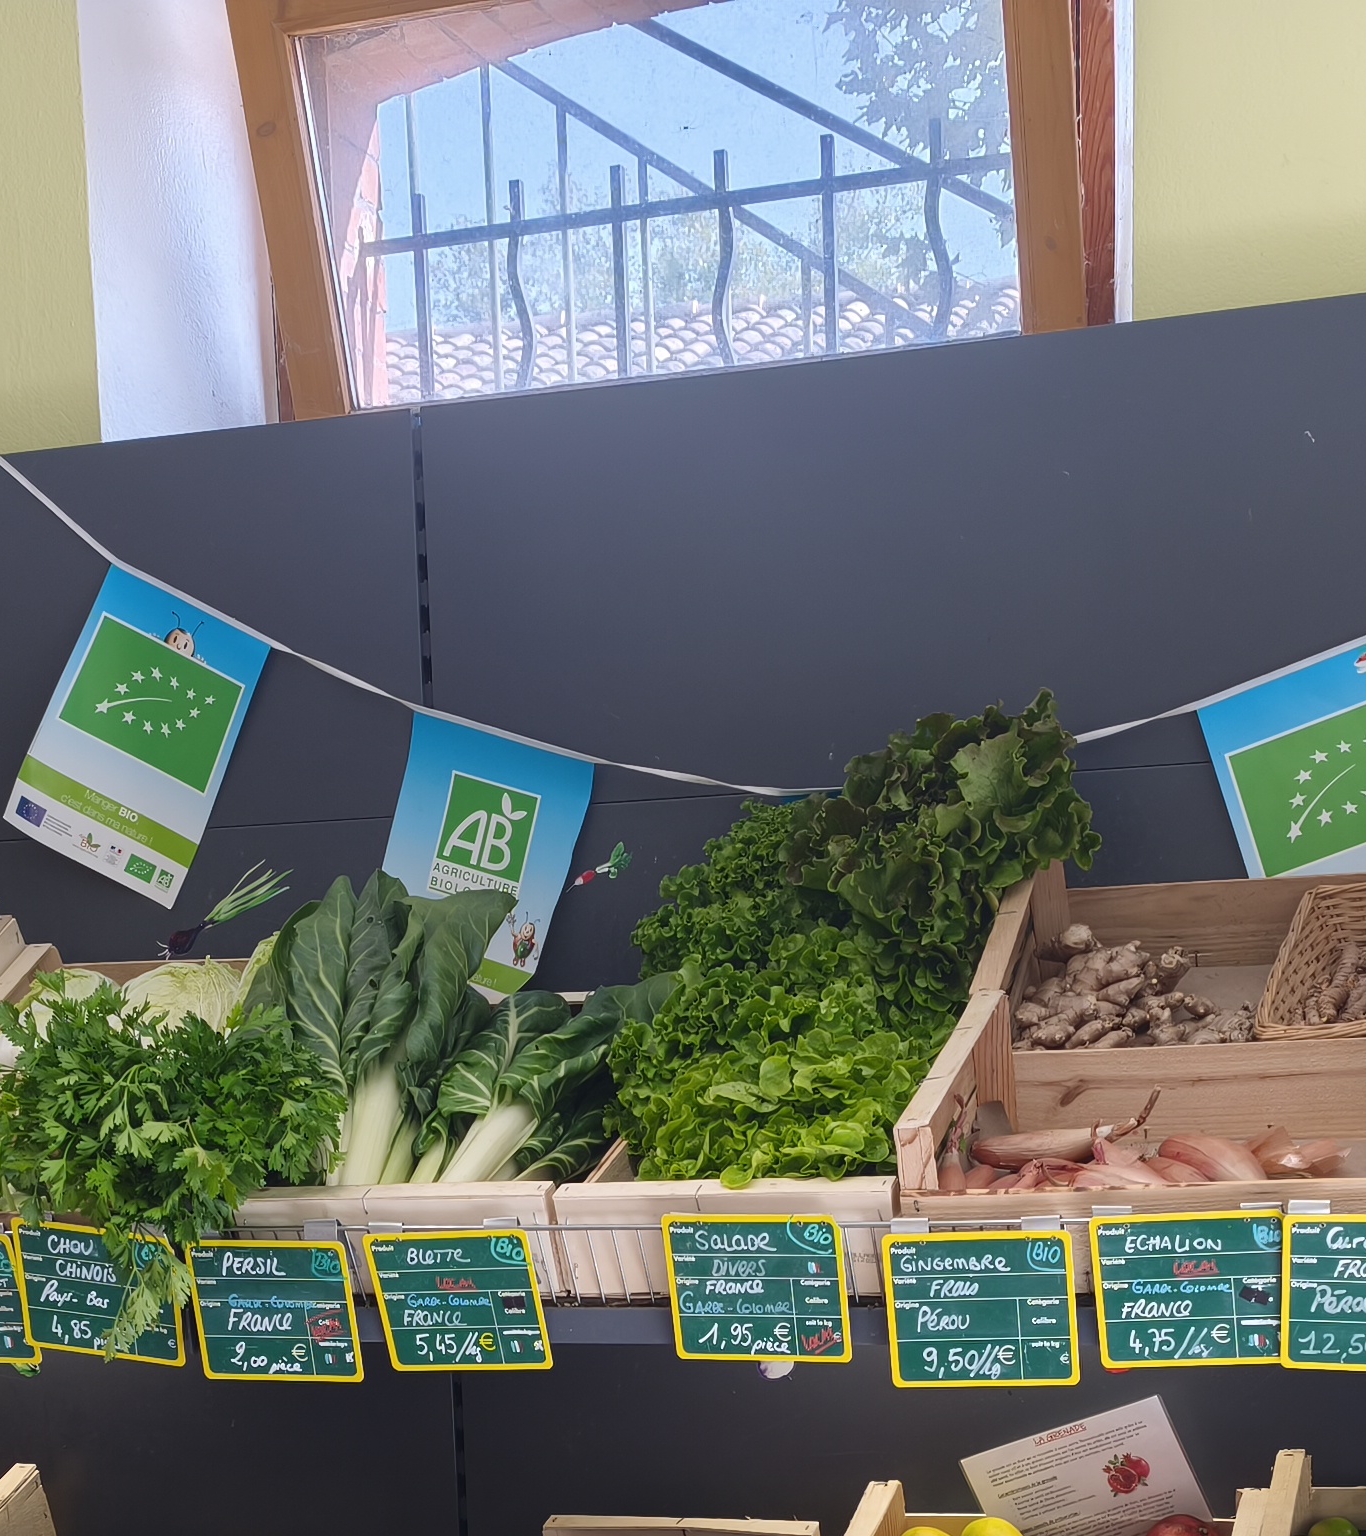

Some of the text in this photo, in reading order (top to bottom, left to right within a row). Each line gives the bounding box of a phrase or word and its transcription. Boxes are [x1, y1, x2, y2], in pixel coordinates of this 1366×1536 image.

[83, 789, 120, 815] Manger
[60, 793, 149, 845] c'est dans ma nature
[443, 809, 513, 872] AB
[432, 862, 519, 897] AGRICULTURE
[46, 1235, 94, 1256] CHOU
[221, 1250, 288, 1277] PERSIL
[899, 1253, 1013, 1273] GINGEMBRE
[1046, 1422, 1088, 1443] GRENADE
